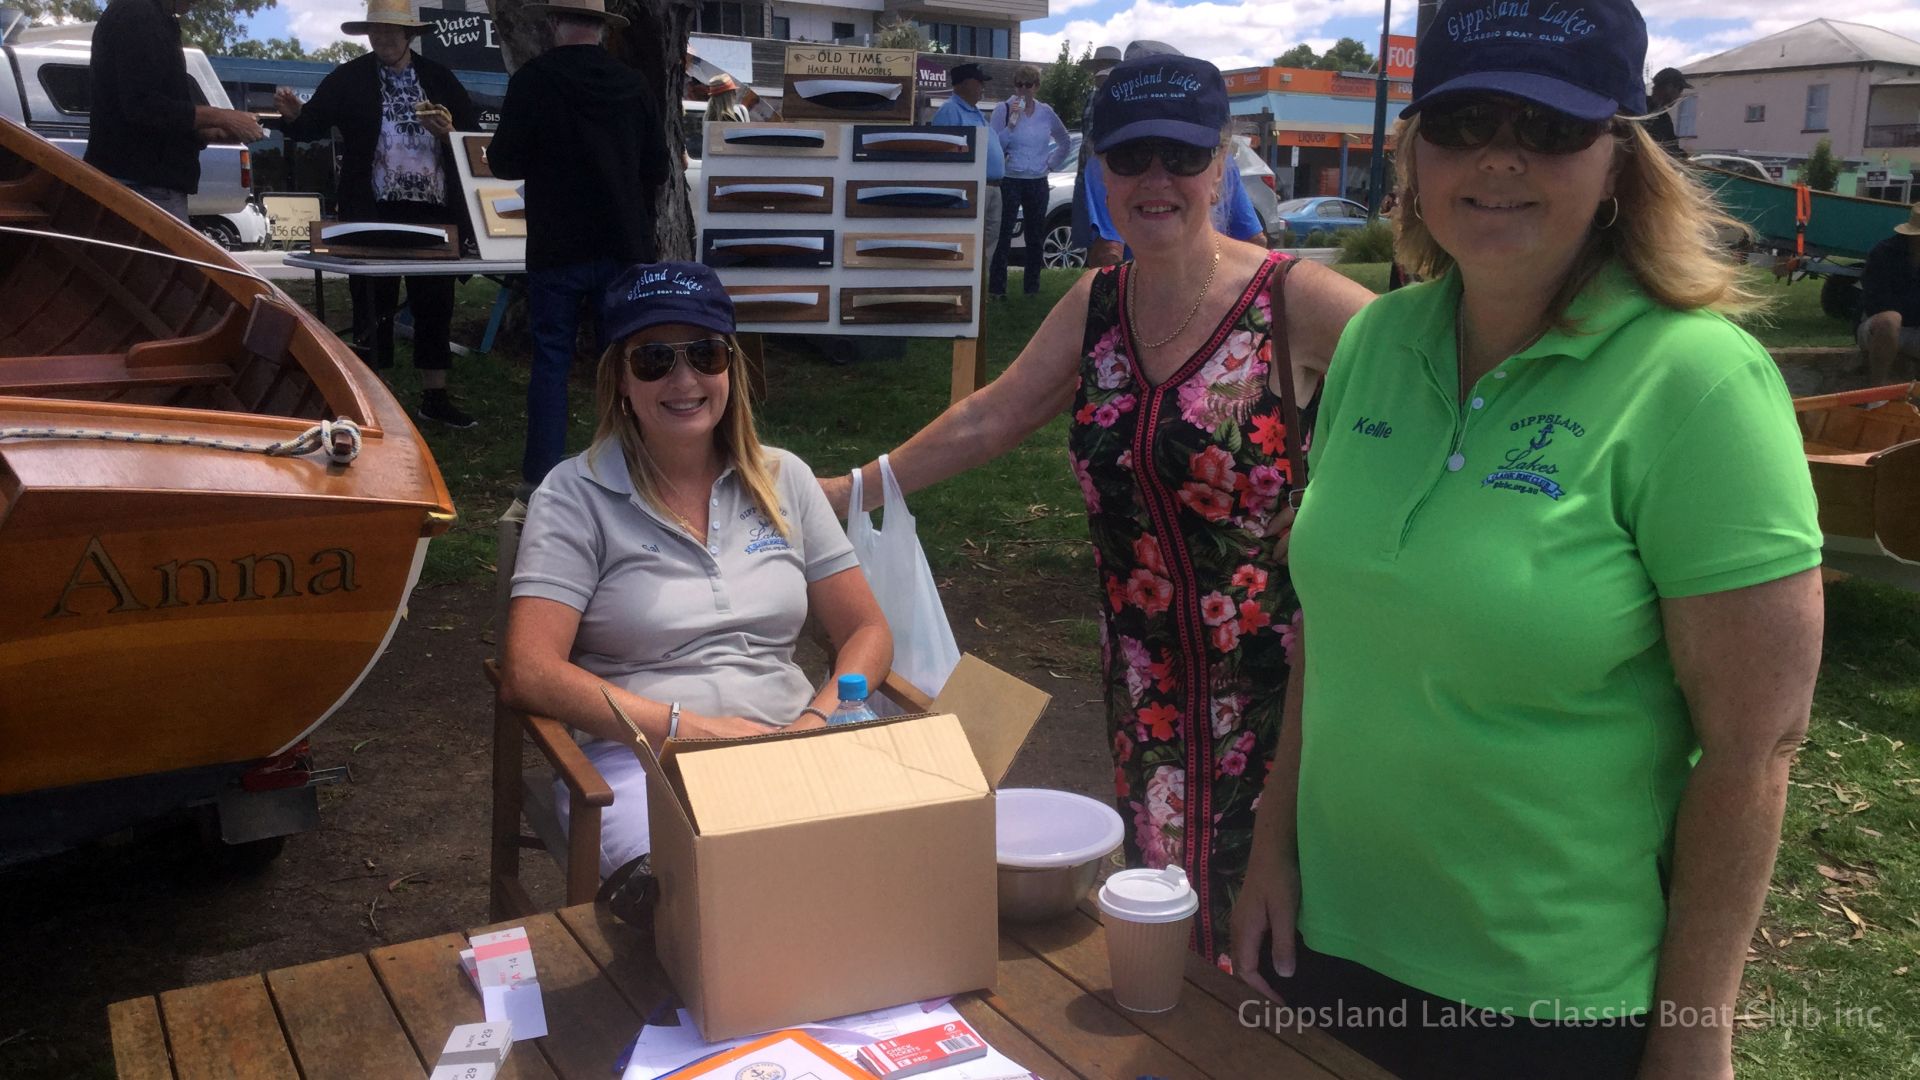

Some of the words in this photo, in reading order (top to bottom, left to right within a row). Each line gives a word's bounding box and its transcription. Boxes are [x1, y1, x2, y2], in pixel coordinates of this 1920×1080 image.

[1448, 0, 1531, 40] Gippsland
[1539, 1, 1596, 35] Lakes
[437, 30, 480, 48] View
[1463, 31, 1501, 43] CLASSIC
[1539, 34, 1565, 42] CLUB
[817, 51, 842, 63] OLD
[848, 52, 882, 64] TIME
[807, 65, 827, 74] HALF
[832, 65, 855, 75] HULL
[920, 69, 947, 82] Ward
[1111, 66, 1164, 101] Gippsland
[1167, 70, 1202, 91] Lakes
[1298, 132, 1328, 143] LIQUOR
[672, 271, 703, 291] Lakes
[1352, 416, 1393, 439] Kellie
[1510, 414, 1585, 438] GIPPSLAND
[1498, 449, 1559, 475] Lakes
[641, 544, 661, 554] Sal
[42, 534, 361, 619] Anna
[481, 1028, 494, 1039] 29
[465, 1067, 477, 1080] 29
